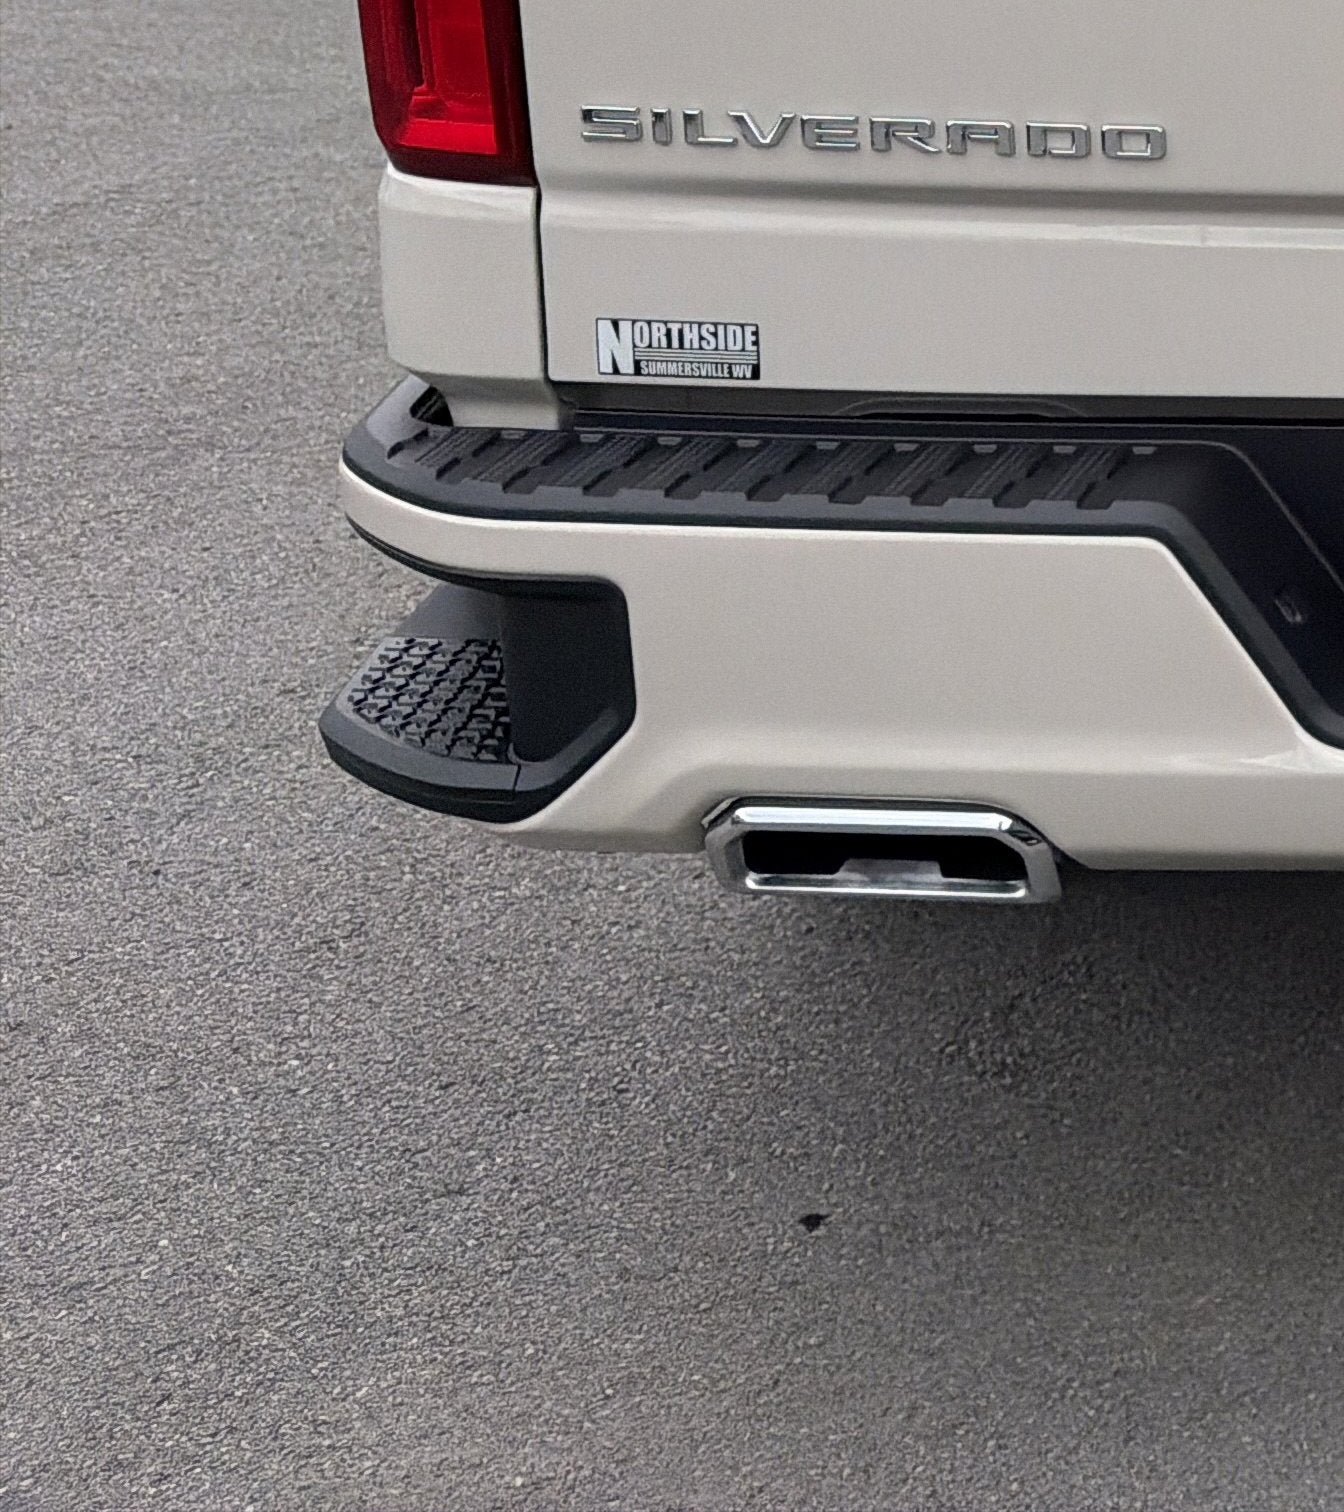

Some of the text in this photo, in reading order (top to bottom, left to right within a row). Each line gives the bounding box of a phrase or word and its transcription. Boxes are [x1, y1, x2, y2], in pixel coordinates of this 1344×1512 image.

[580, 104, 1167, 160] SILVERADO
[597, 319, 758, 375] NORTHSIDE
[639, 360, 753, 379] SUMMERSVILLE WV
